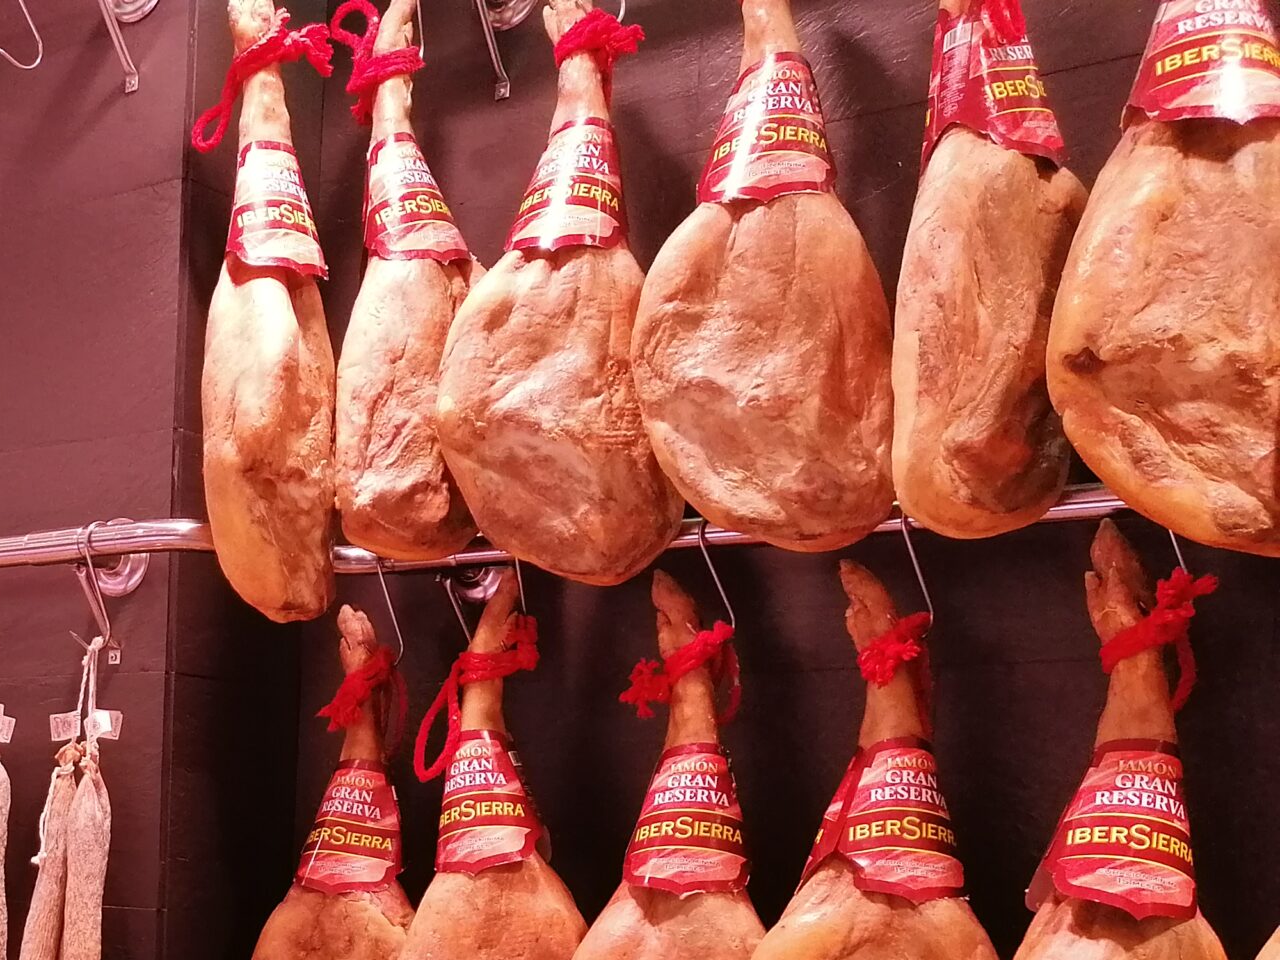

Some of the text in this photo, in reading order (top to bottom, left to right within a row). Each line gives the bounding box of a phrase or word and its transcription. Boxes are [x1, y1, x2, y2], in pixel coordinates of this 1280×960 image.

[450, 758, 493, 776] GRAN
[670, 758, 718, 773] JAMÓN
[1117, 759, 1177, 779] JAMÓN
[444, 772, 507, 794] RESERVA
[667, 774, 718, 789] GRAN
[885, 769, 937, 789] GRAN
[1115, 773, 1177, 797] GRAN
[332, 787, 373, 804] GRAN
[653, 789, 729, 807] RESERVA
[870, 785, 947, 810] RESERVA
[1095, 790, 1185, 820] RESERVA
[322, 799, 382, 820] RESERVA
[635, 816, 743, 845] IBERSIERRA
